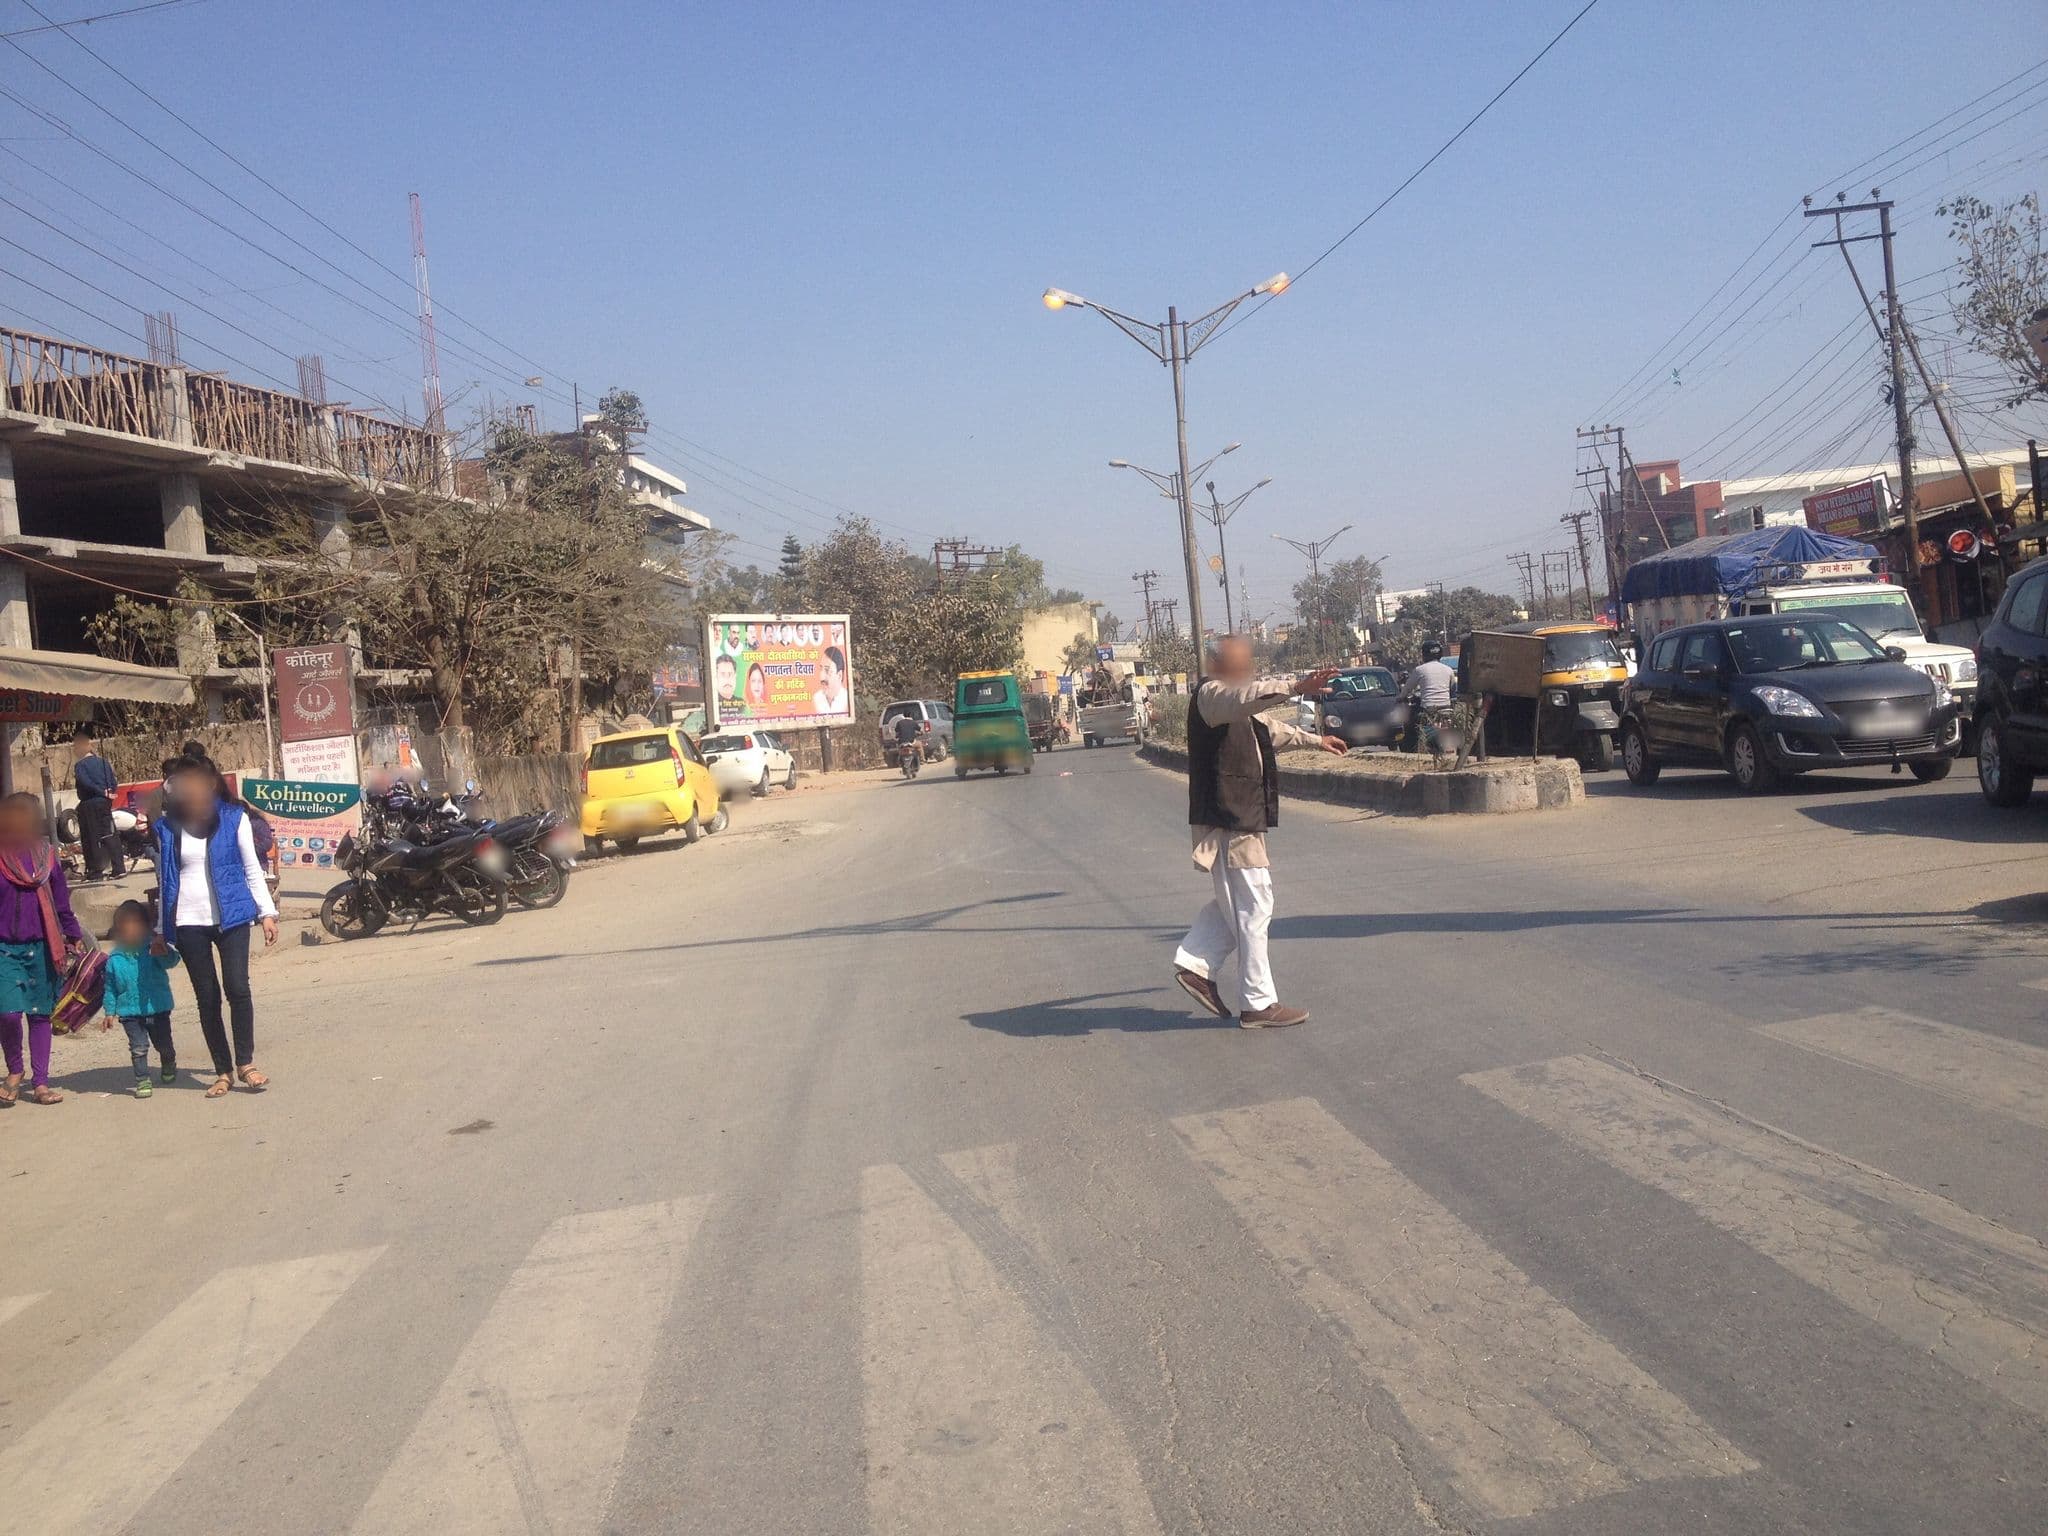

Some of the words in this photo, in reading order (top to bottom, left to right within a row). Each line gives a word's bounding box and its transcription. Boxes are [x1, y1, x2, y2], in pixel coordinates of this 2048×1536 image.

[285, 650, 334, 669] कोहिनूर
[795, 661, 814, 675] दिवस
[26, 691, 62, 715] Shop
[327, 750, 346, 761] पहली
[255, 784, 347, 804] Kohinoor
[264, 801, 284, 811] Art
[286, 801, 335, 814] Jewellers
